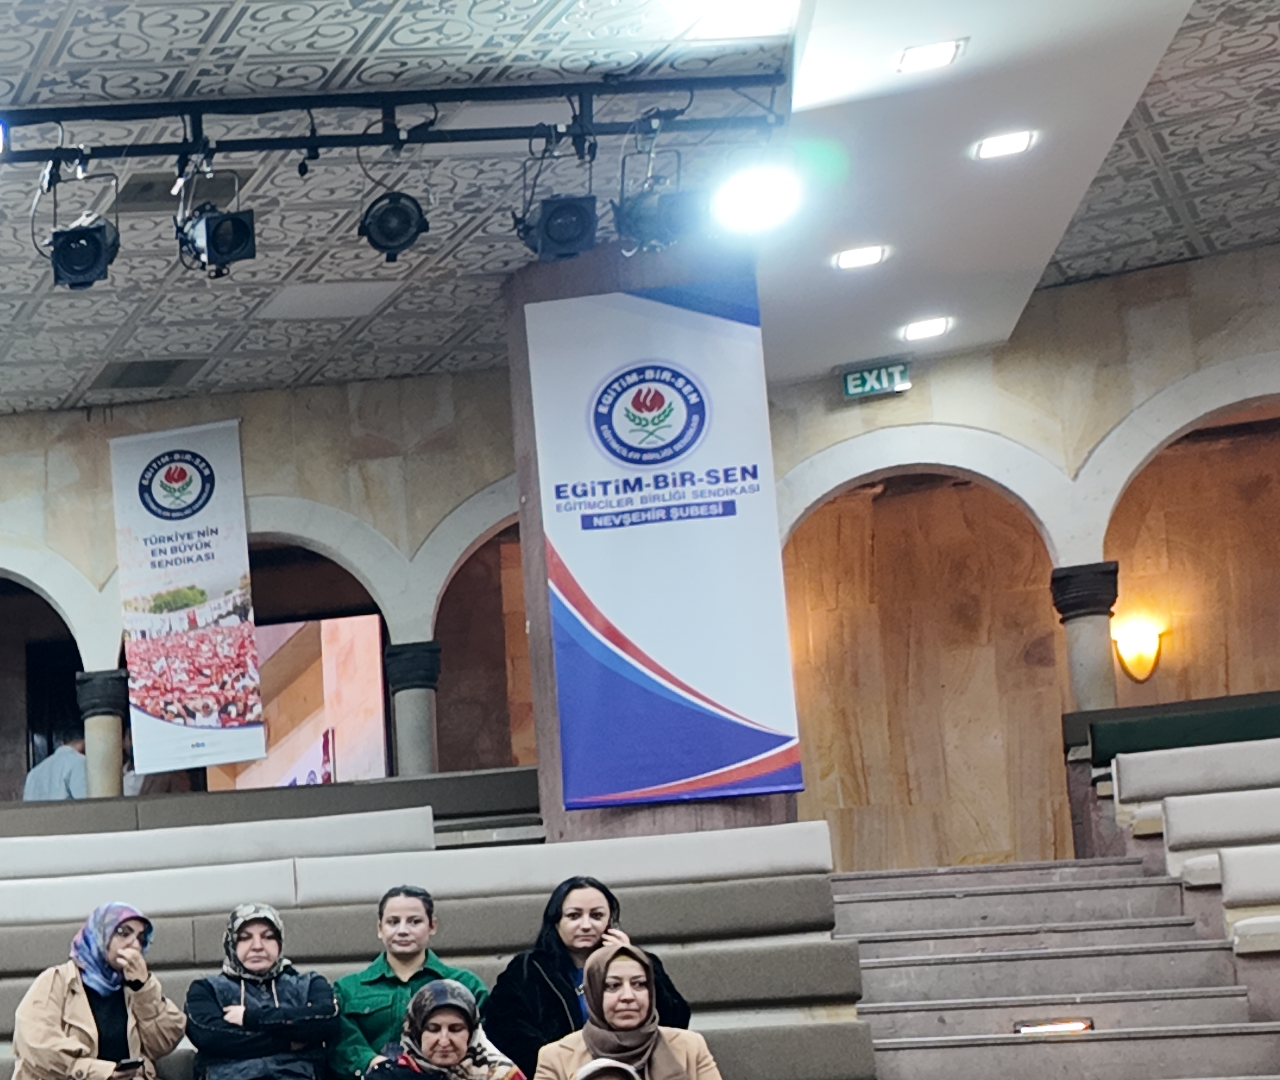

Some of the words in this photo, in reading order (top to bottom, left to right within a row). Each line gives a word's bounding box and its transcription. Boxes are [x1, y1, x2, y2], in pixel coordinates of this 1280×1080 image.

[846, 365, 905, 394] EXIT
[592, 507, 667, 528] NEVŞEHİR
[669, 502, 724, 520] ŞUBESİ
